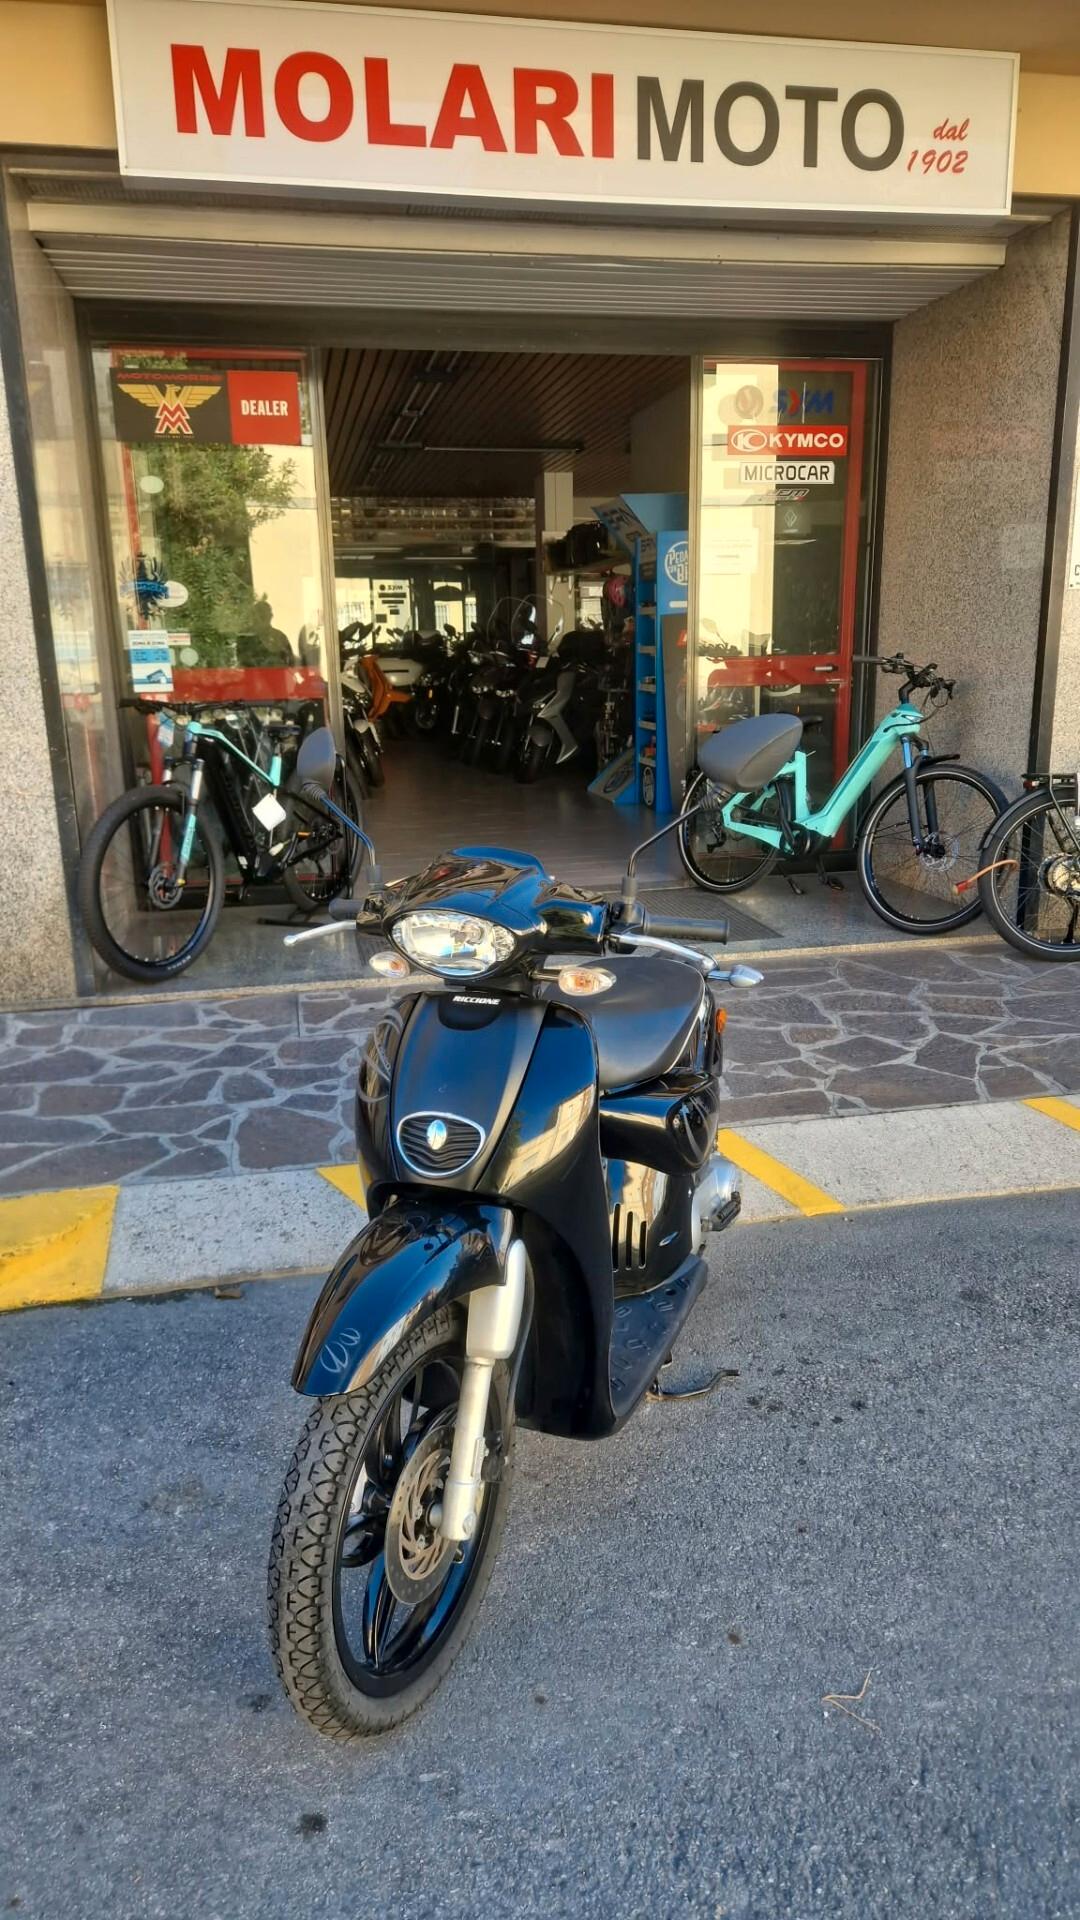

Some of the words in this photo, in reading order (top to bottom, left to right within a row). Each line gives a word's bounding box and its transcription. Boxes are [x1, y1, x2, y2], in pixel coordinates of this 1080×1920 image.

[170, 42, 615, 159] MOLARI
[635, 75, 906, 171] MOTO
[932, 117, 969, 142] dal
[906, 147, 969, 175] 1902
[240, 399, 288, 417] DEALER
[769, 433, 844, 448] KYMCO
[744, 465, 830, 481] MICROCAR
[668, 549, 689, 565] PEDA
[453, 995, 501, 1005] RICCIONE
